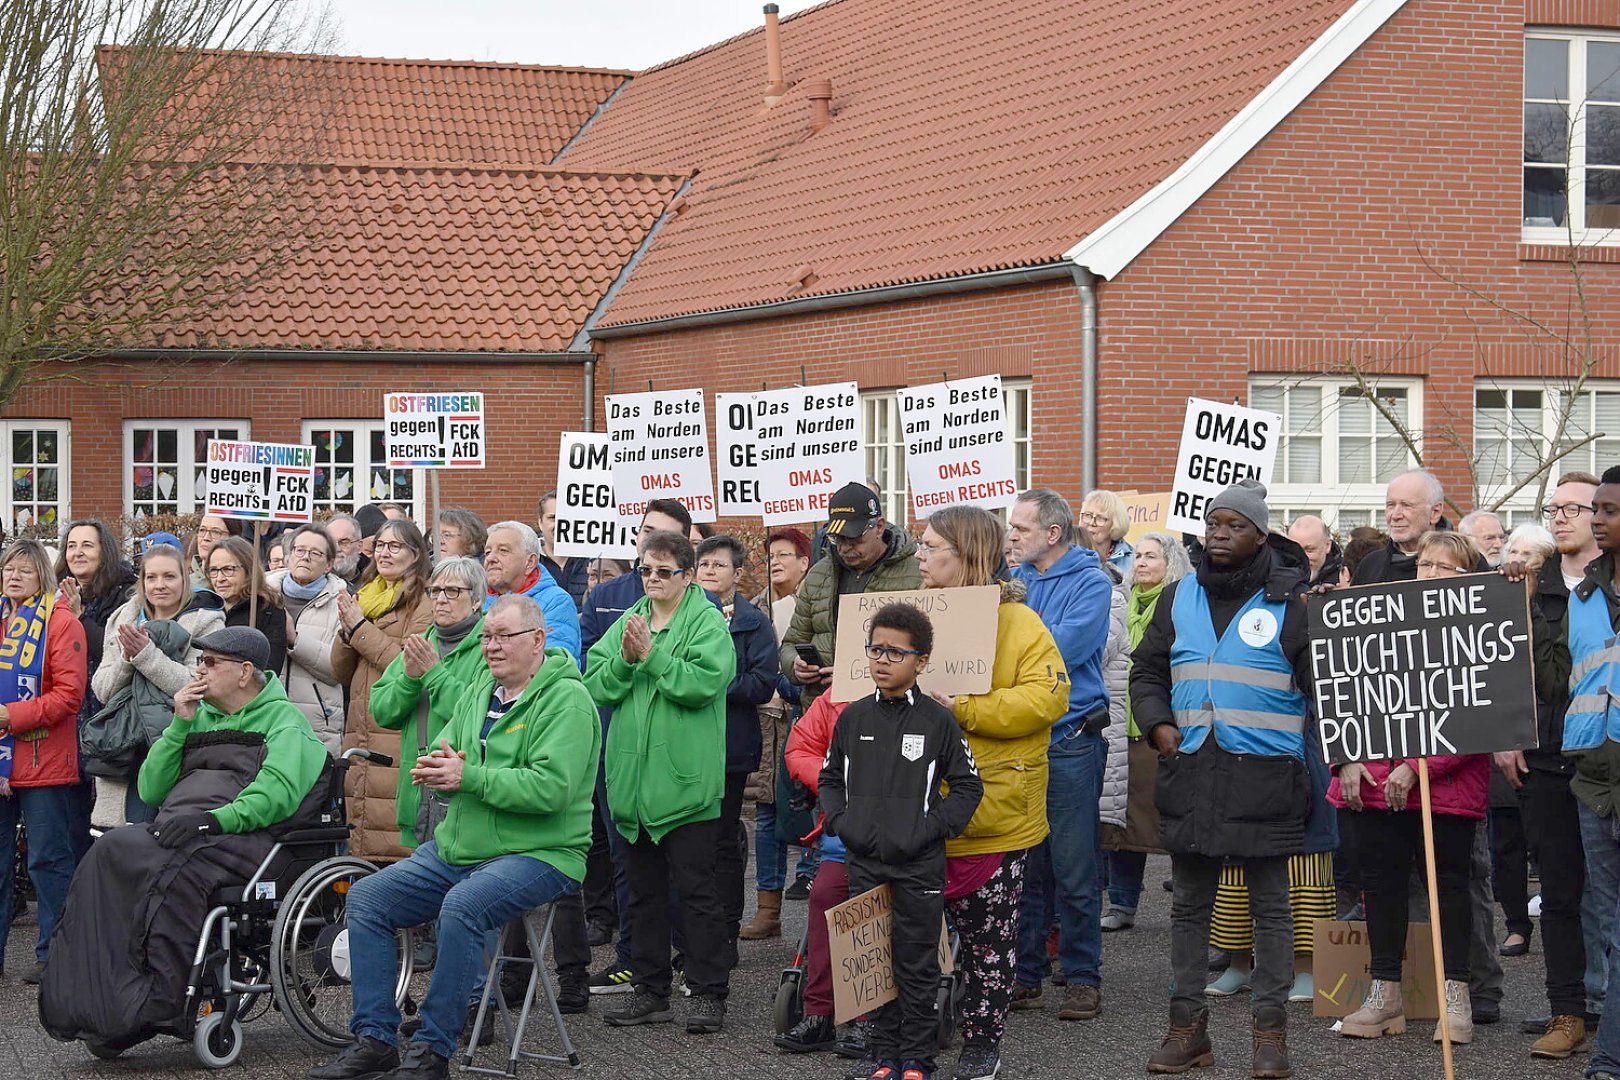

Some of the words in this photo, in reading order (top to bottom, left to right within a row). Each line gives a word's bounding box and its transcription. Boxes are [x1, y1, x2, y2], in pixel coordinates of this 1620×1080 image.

[389, 396, 480, 413] OSTFRIESEN
[610, 403, 640, 419] Das
[654, 399, 701, 416] Beste
[757, 400, 790, 416] Das
[804, 393, 854, 412] Beste
[904, 396, 935, 412] Das
[949, 386, 998, 406] Beste
[390, 420, 436, 436] gegen
[758, 425, 783, 440] am
[796, 416, 854, 436] Norden
[906, 419, 930, 434] am
[943, 408, 1000, 428] Norden
[1195, 410, 1269, 451] OMAS
[450, 424, 480, 440] FCK
[612, 428, 635, 442] am
[647, 422, 701, 439] Norden
[390, 444, 437, 458] RECHTS
[452, 442, 478, 458] AfD
[760, 442, 796, 461] sind
[802, 439, 858, 457] unsere
[910, 436, 942, 456] sind
[948, 430, 1004, 449] unsere
[210, 442, 312, 467] OSTFRIESINNEN
[569, 442, 612, 470] OM
[614, 446, 646, 462] sind
[652, 445, 704, 460] unsere
[210, 468, 261, 486] gegen
[788, 468, 833, 487] OMAS
[938, 460, 982, 480] OMAS
[276, 476, 309, 494] FCK
[640, 473, 682, 490] OMAS
[209, 492, 260, 509] RECHTS
[277, 494, 306, 512] AfD
[566, 483, 616, 508] GEG
[916, 490, 955, 508] GEGEN
[958, 479, 1016, 501] RECHTS
[618, 502, 647, 516] GEGE
[764, 498, 804, 514] GEGEN
[1322, 592, 1406, 629] GEGEN
[1422, 584, 1488, 620] EINE
[1310, 620, 1528, 680] FLÜCHTLINGS-
[944, 659, 987, 676] WIRD
[1314, 664, 1492, 719] FEINDLICHE
[1318, 710, 1458, 764] POLITIK
[842, 944, 892, 982] SONDERN
